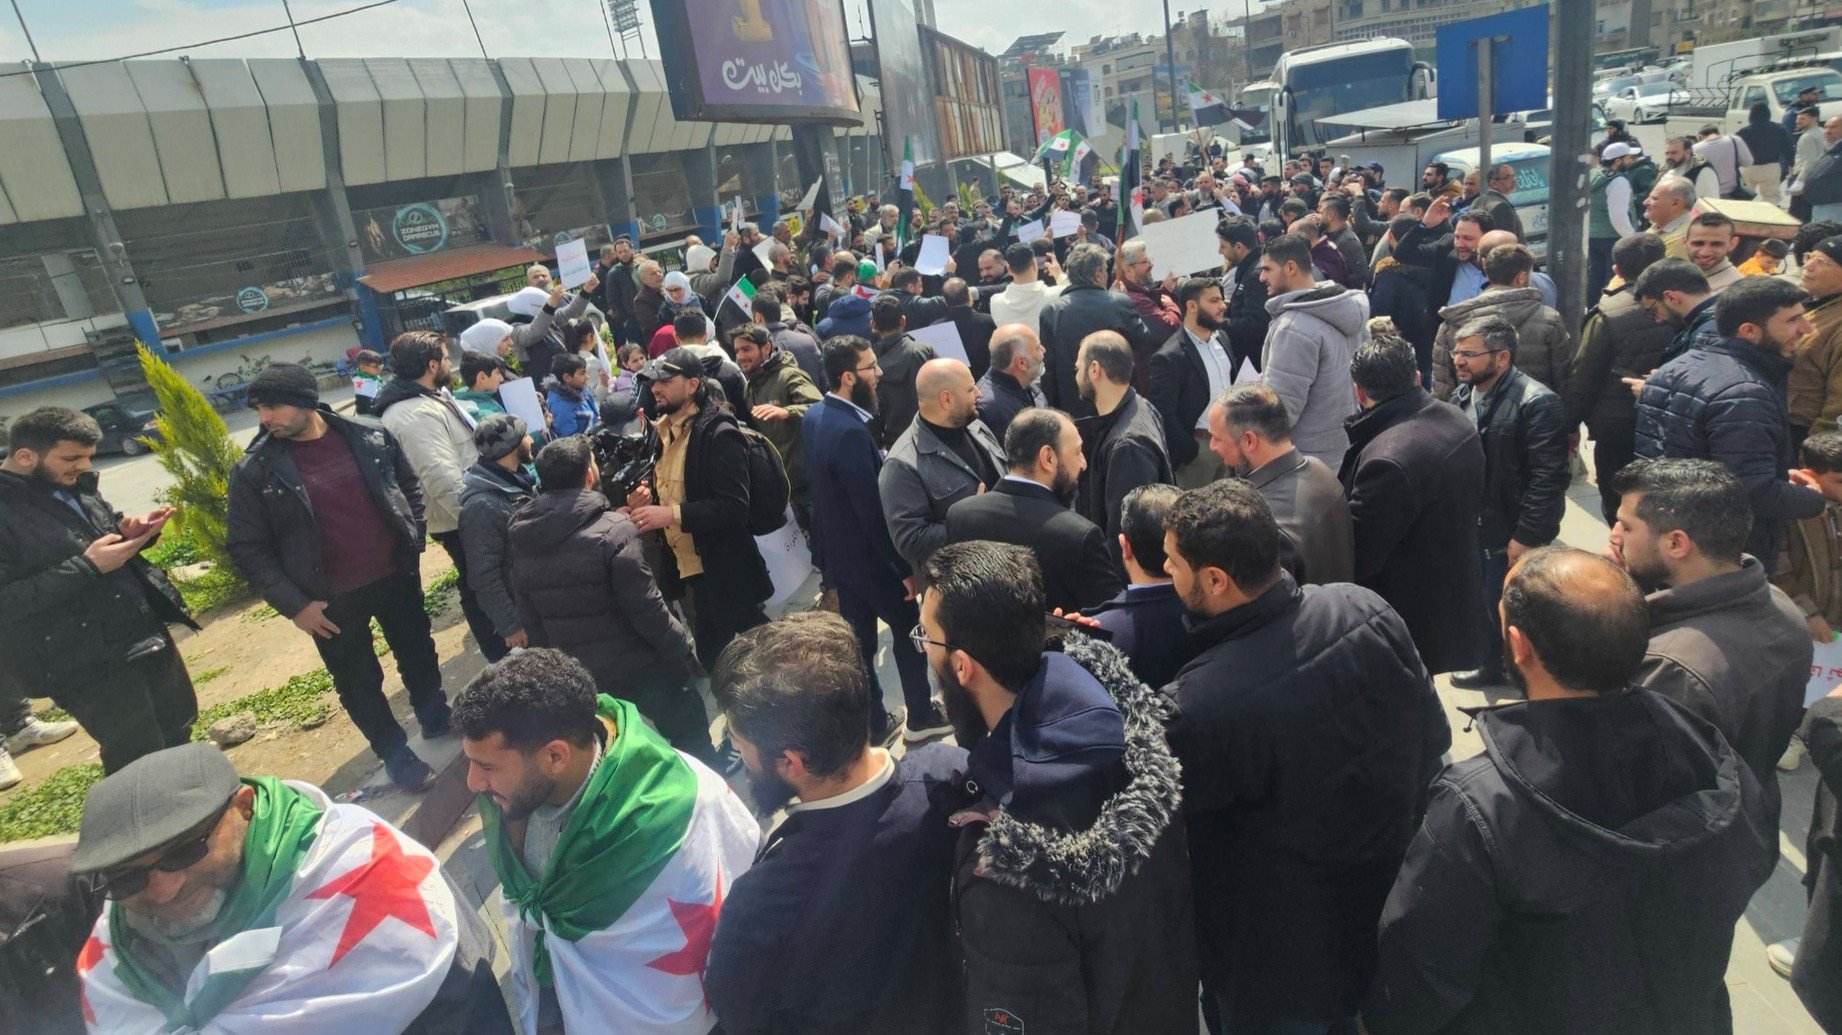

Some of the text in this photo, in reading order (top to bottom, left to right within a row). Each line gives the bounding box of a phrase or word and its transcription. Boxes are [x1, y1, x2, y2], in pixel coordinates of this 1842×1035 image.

[722, 57, 803, 96] بكل بيت
[403, 229, 440, 241] DAMASCUS
